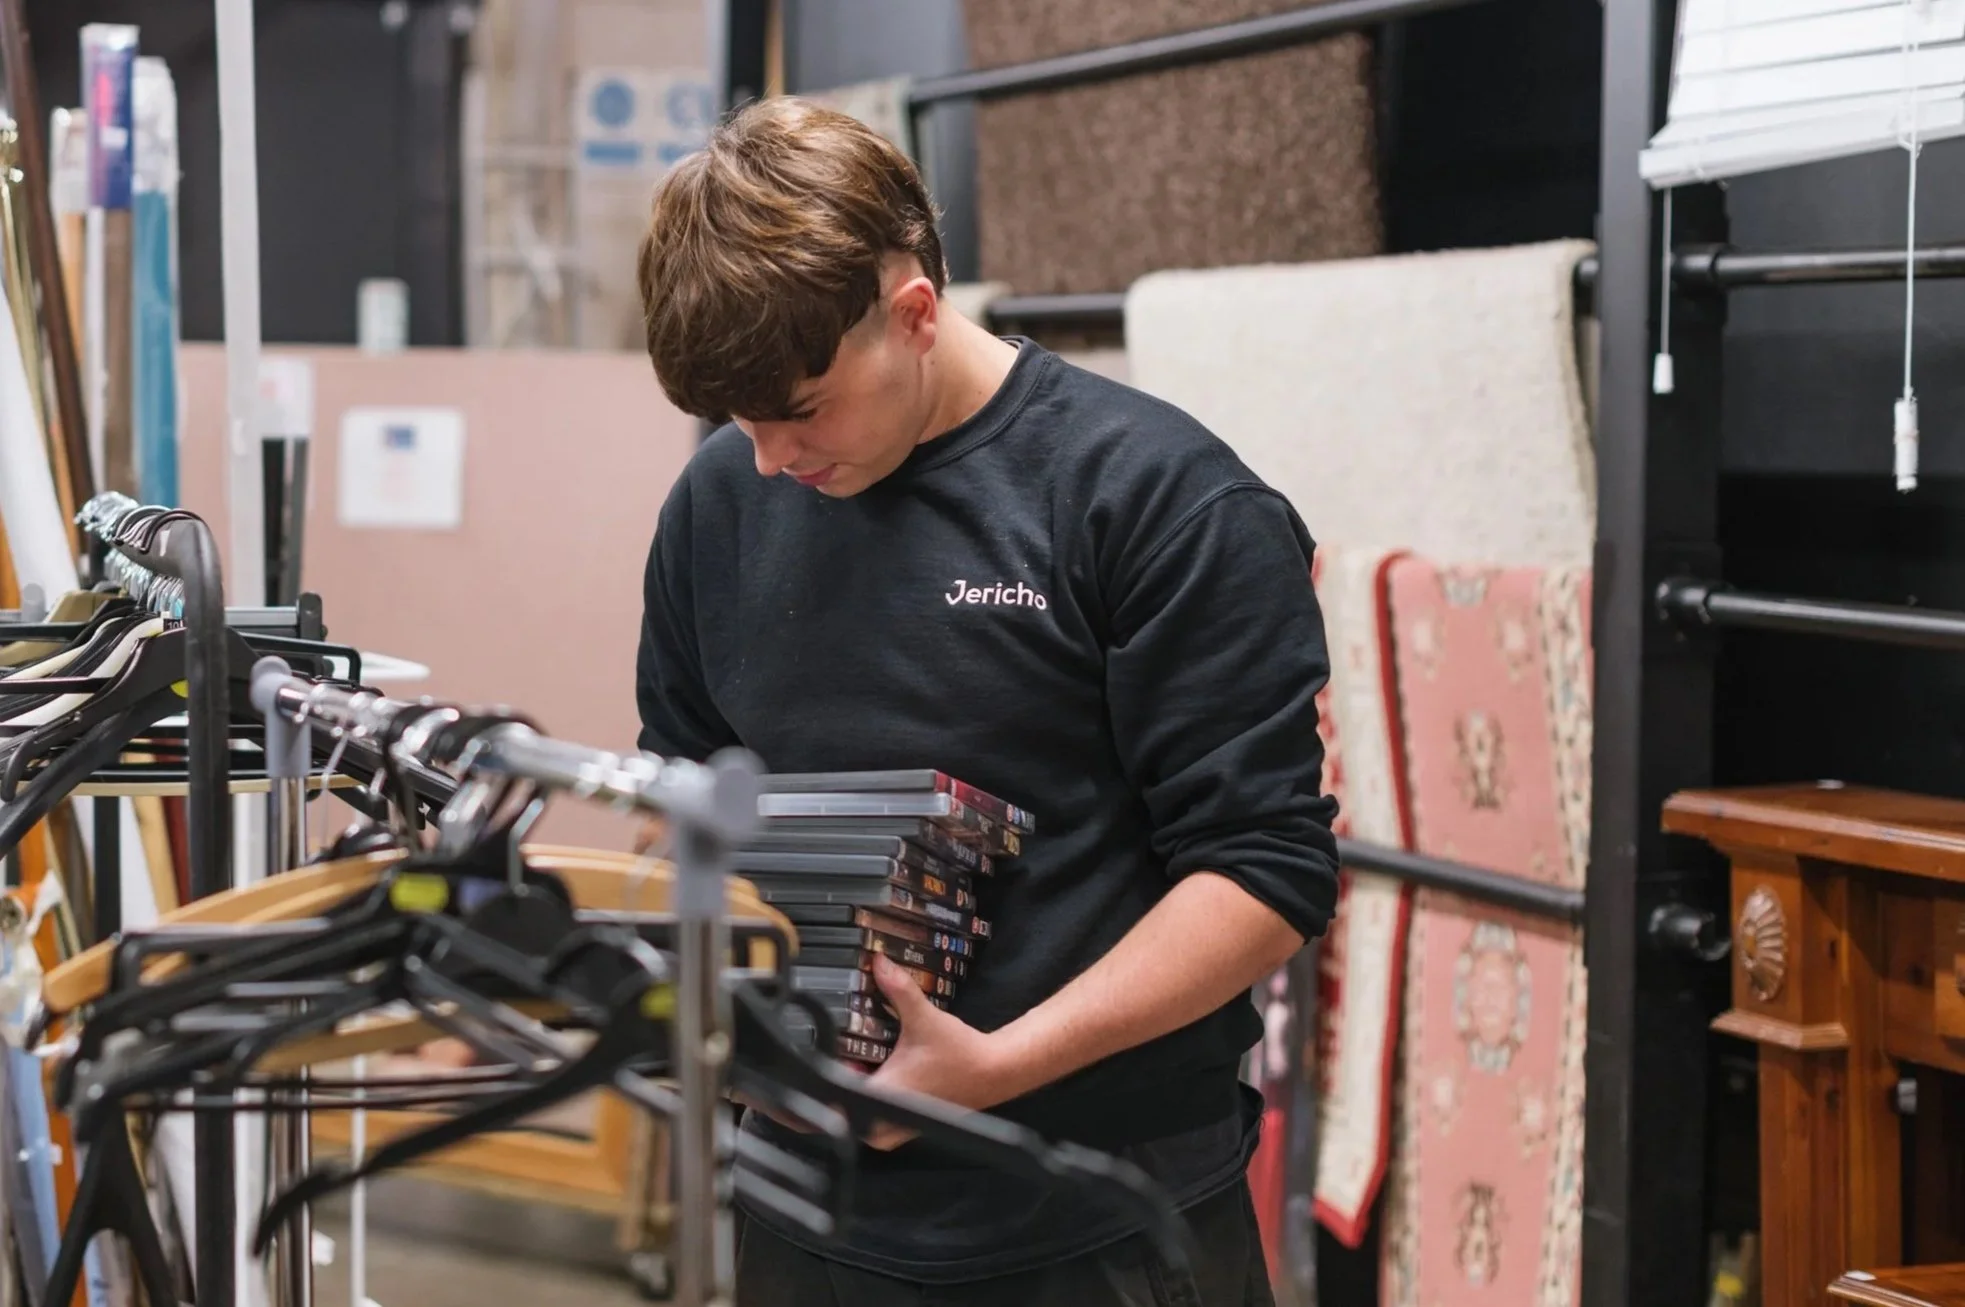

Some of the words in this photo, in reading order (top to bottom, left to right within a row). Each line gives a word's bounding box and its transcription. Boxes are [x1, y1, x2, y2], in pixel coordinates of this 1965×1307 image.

[945, 579, 1047, 611] Jericho
[847, 1038, 868, 1056] THE
[872, 1044, 893, 1060] PU
